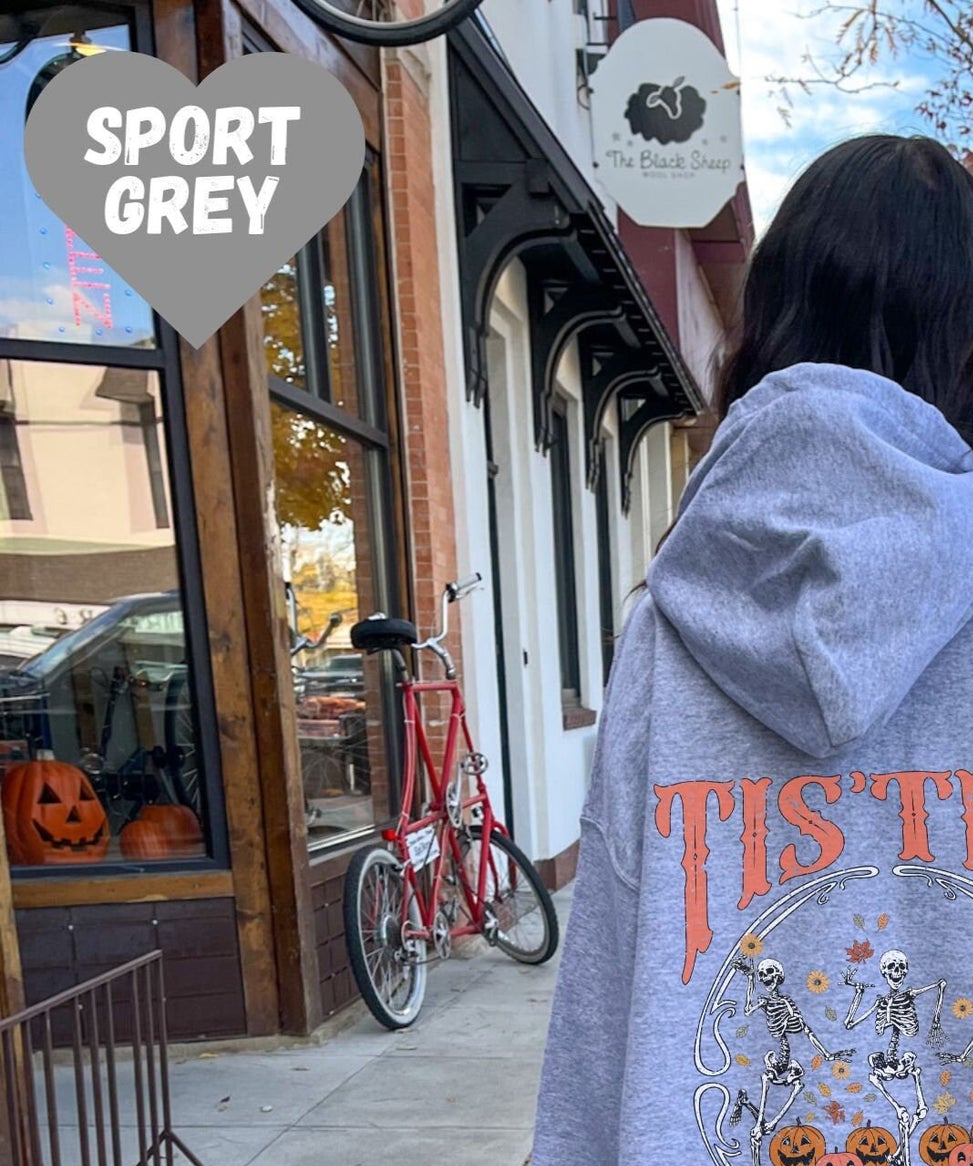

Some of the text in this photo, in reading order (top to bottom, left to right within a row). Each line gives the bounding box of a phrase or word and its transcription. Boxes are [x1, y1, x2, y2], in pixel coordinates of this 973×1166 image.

[605, 149, 732, 174] The Black Sheep
